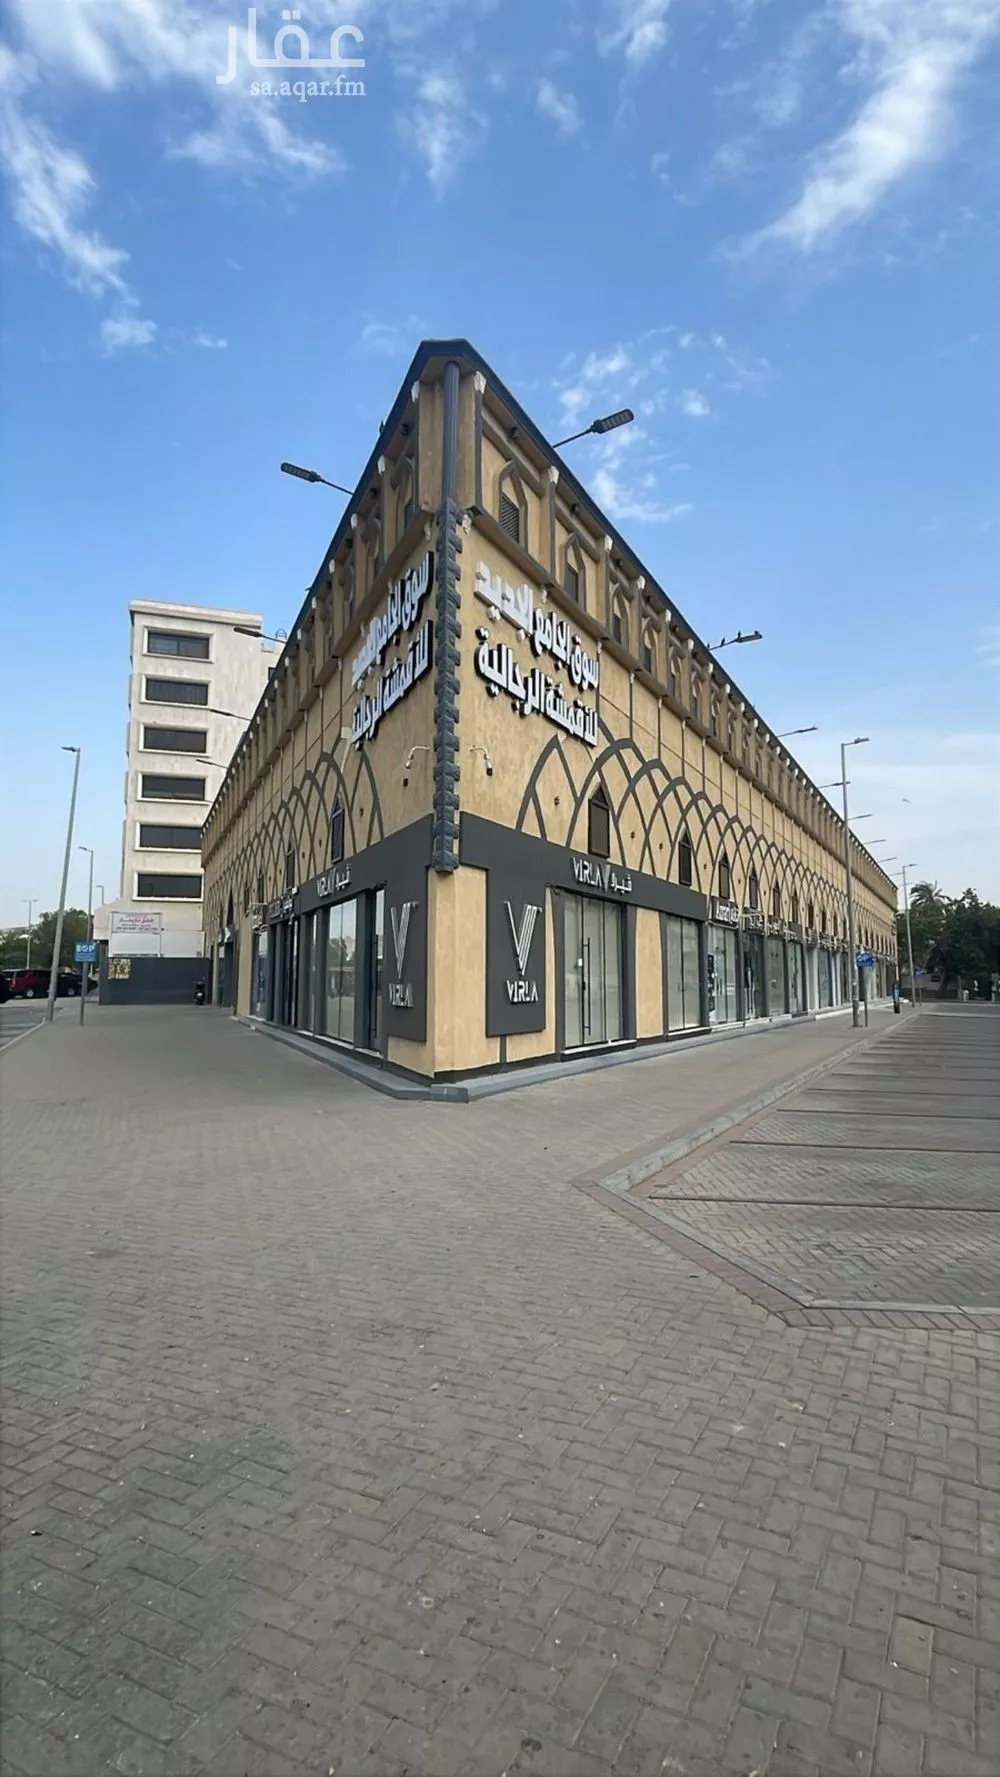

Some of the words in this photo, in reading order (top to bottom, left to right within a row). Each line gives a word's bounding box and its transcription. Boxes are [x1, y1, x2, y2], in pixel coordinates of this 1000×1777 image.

[376, 581, 402, 664] الجامع
[402, 552, 429, 631] سوق
[475, 561, 533, 641] الجديد
[478, 626, 545, 715] الرجالية
[534, 608, 570, 670] الجامع
[570, 635, 599, 689] سوق
[546, 675, 598, 746] للأقمشة
[572, 857, 603, 887] VIRLA
[389, 983, 414, 1007] VIRLA
[506, 980, 539, 1003] VIRLA
